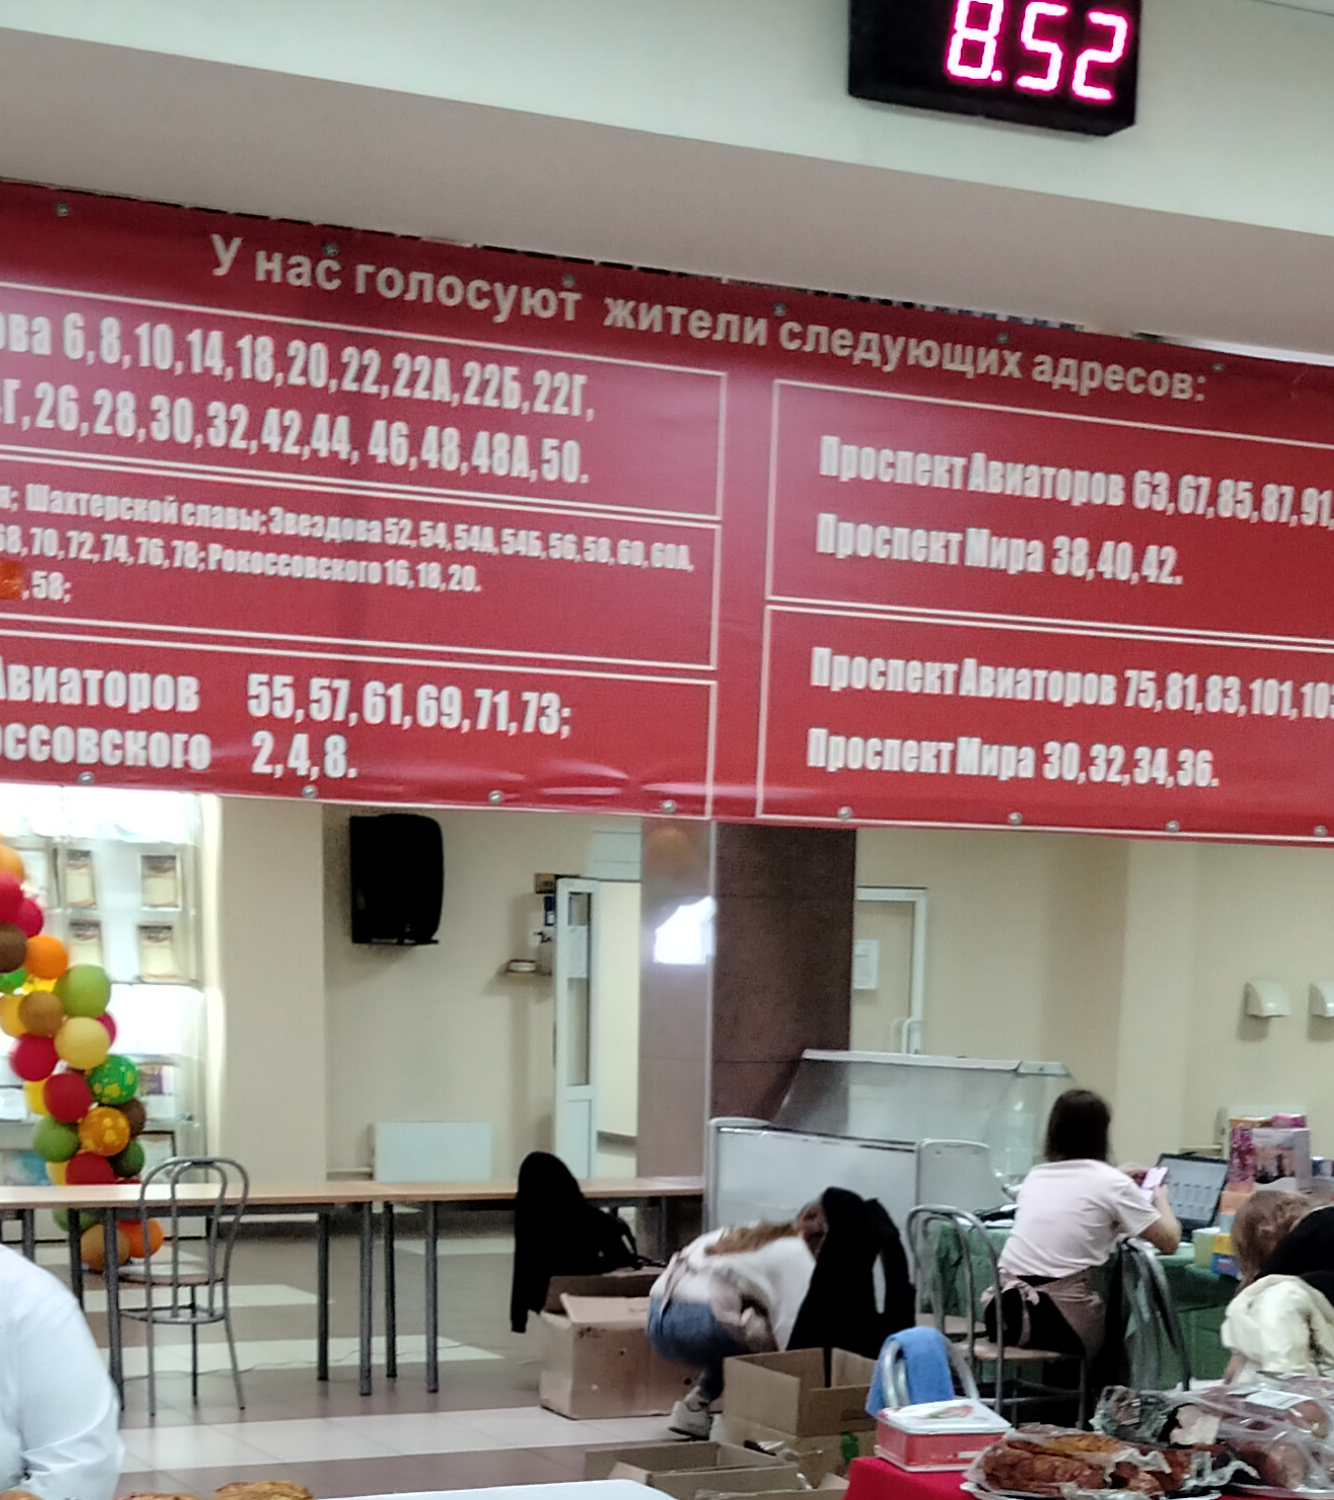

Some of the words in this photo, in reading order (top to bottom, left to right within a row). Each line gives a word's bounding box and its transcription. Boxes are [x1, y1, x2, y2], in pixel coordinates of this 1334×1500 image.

[211, 234, 242, 276] У
[255, 250, 341, 291] нас
[355, 265, 582, 323] голосуют
[603, 297, 767, 347] жители
[779, 321, 1022, 380] следующих
[1032, 355, 1206, 402] адресов:
[819, 435, 967, 490] Проспект
[968, 452, 1126, 507] Авиаторов
[816, 512, 963, 566] Проспект
[964, 527, 1045, 574] Мира
[810, 646, 959, 695] Проспект
[959, 657, 1118, 708] Авиаторов
[807, 727, 955, 775] Проспект
[955, 736, 1036, 781] Мира
